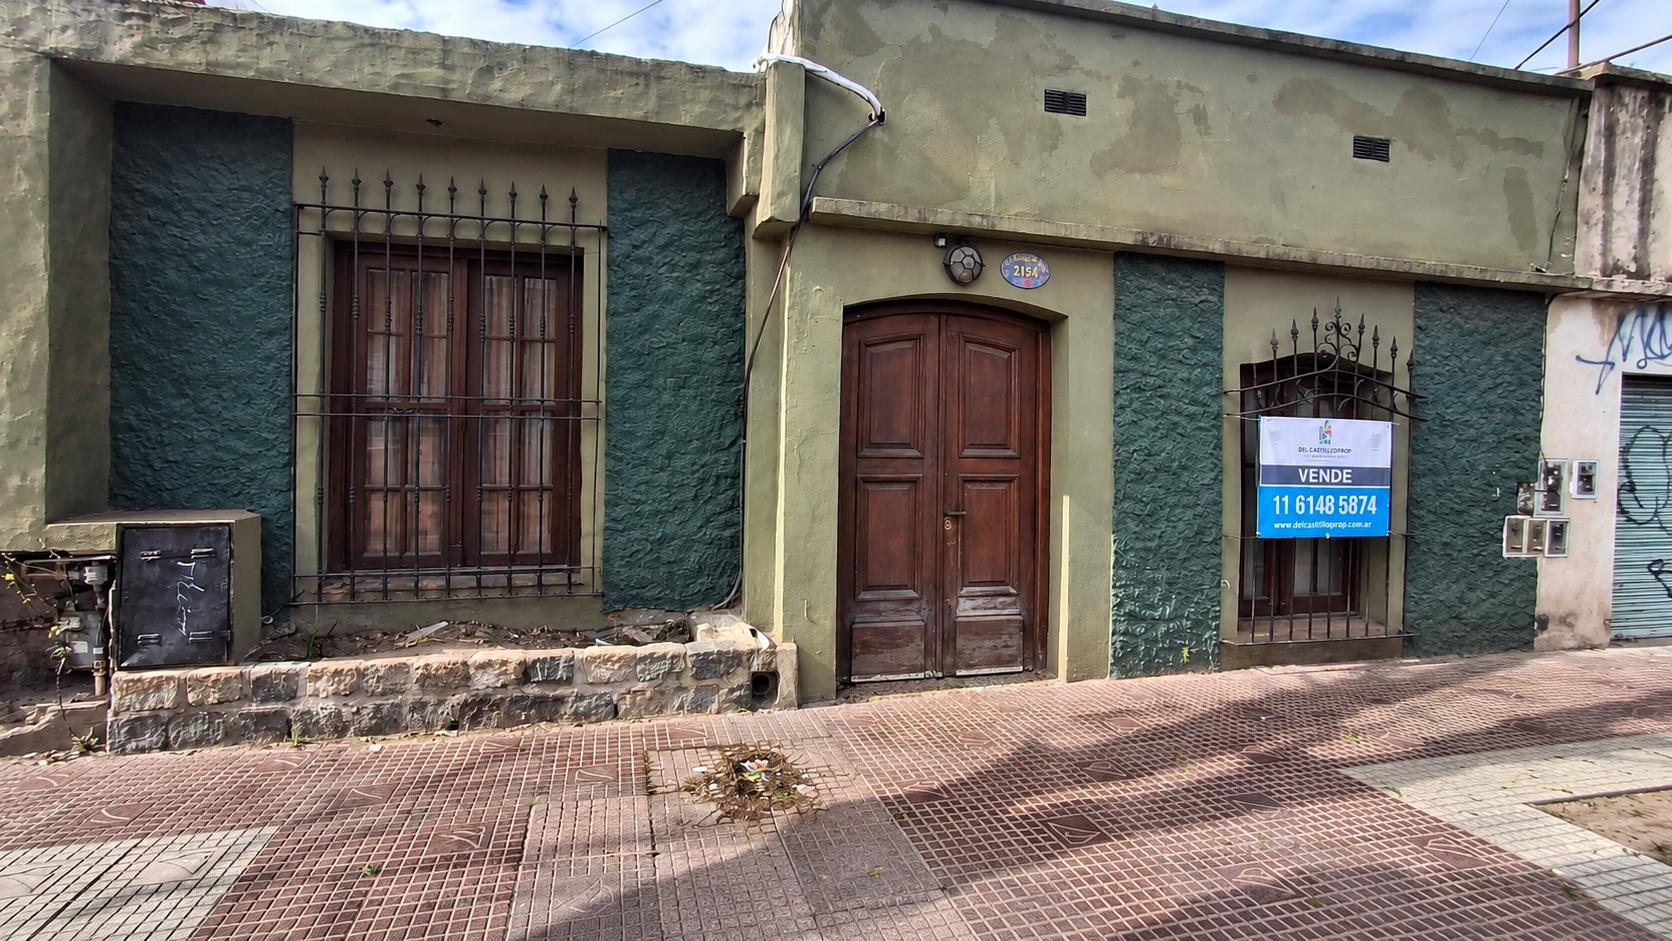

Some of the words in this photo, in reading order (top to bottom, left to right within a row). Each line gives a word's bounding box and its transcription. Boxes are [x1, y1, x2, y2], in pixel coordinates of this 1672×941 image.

[1013, 265, 1039, 279] 2154
[1298, 468, 1352, 483] VENDE
[1273, 495, 1289, 515] 11
[1295, 495, 1335, 515] 6148
[1338, 495, 1377, 515] 5874
